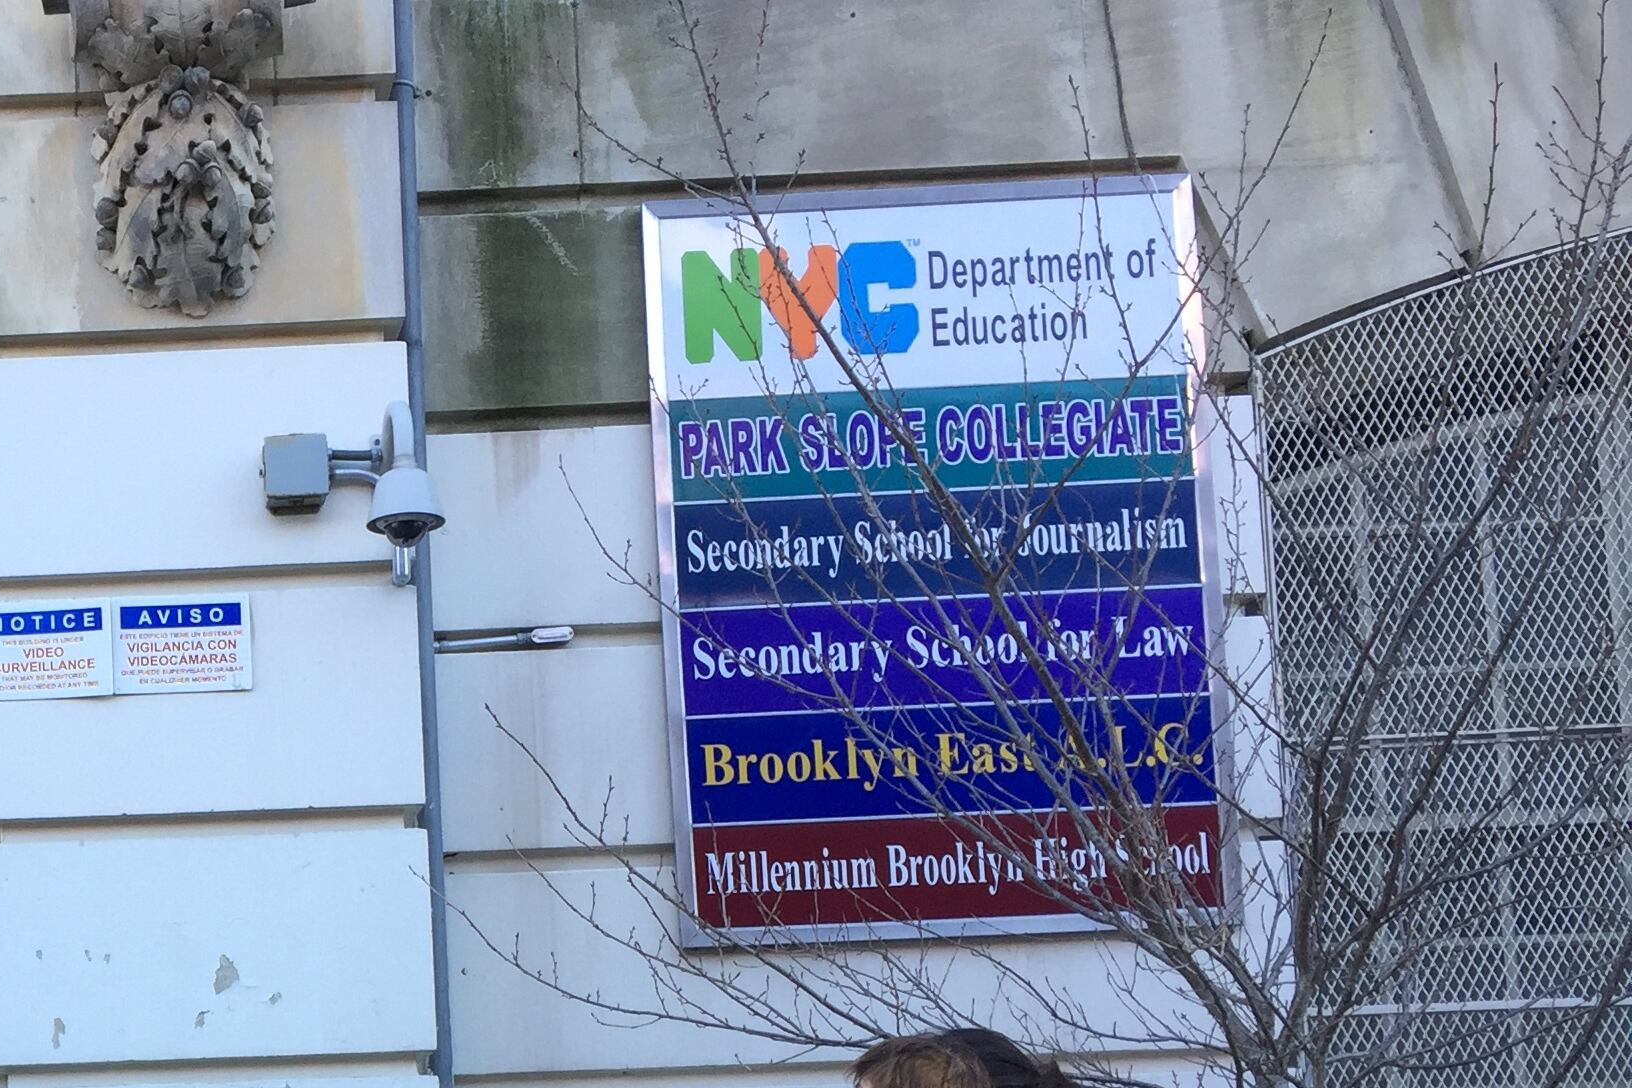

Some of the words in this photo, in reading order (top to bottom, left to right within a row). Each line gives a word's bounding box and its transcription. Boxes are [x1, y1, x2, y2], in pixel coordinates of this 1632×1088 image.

[929, 249, 1115, 296] Department
[1127, 239, 1156, 279] of
[681, 240, 919, 364] NYC
[931, 303, 1088, 347] Education
[679, 416, 790, 479] PARK
[800, 408, 928, 473] SLOPE
[938, 395, 1184, 465] COLLEGIATE
[687, 525, 844, 577] Secondary
[855, 518, 953, 564] School
[964, 516, 1006, 560] for
[1018, 507, 1187, 557] Journalism
[138, 607, 225, 626] AVISO
[23, 647, 64, 659] VIDEO
[127, 640, 204, 653] VIGILANCIA
[208, 639, 237, 650] CON
[128, 653, 237, 667] VIDEOCÁMARAS
[693, 632, 892, 683] Secondary
[906, 620, 1028, 669] School
[1045, 618, 1097, 662] for
[1111, 616, 1193, 658] Law
[701, 734, 917, 792] Brooklyn
[934, 732, 1036, 776] East
[706, 846, 875, 896] Millennium
[887, 840, 1024, 896] Brooklyn
[1032, 835, 1107, 892] High
